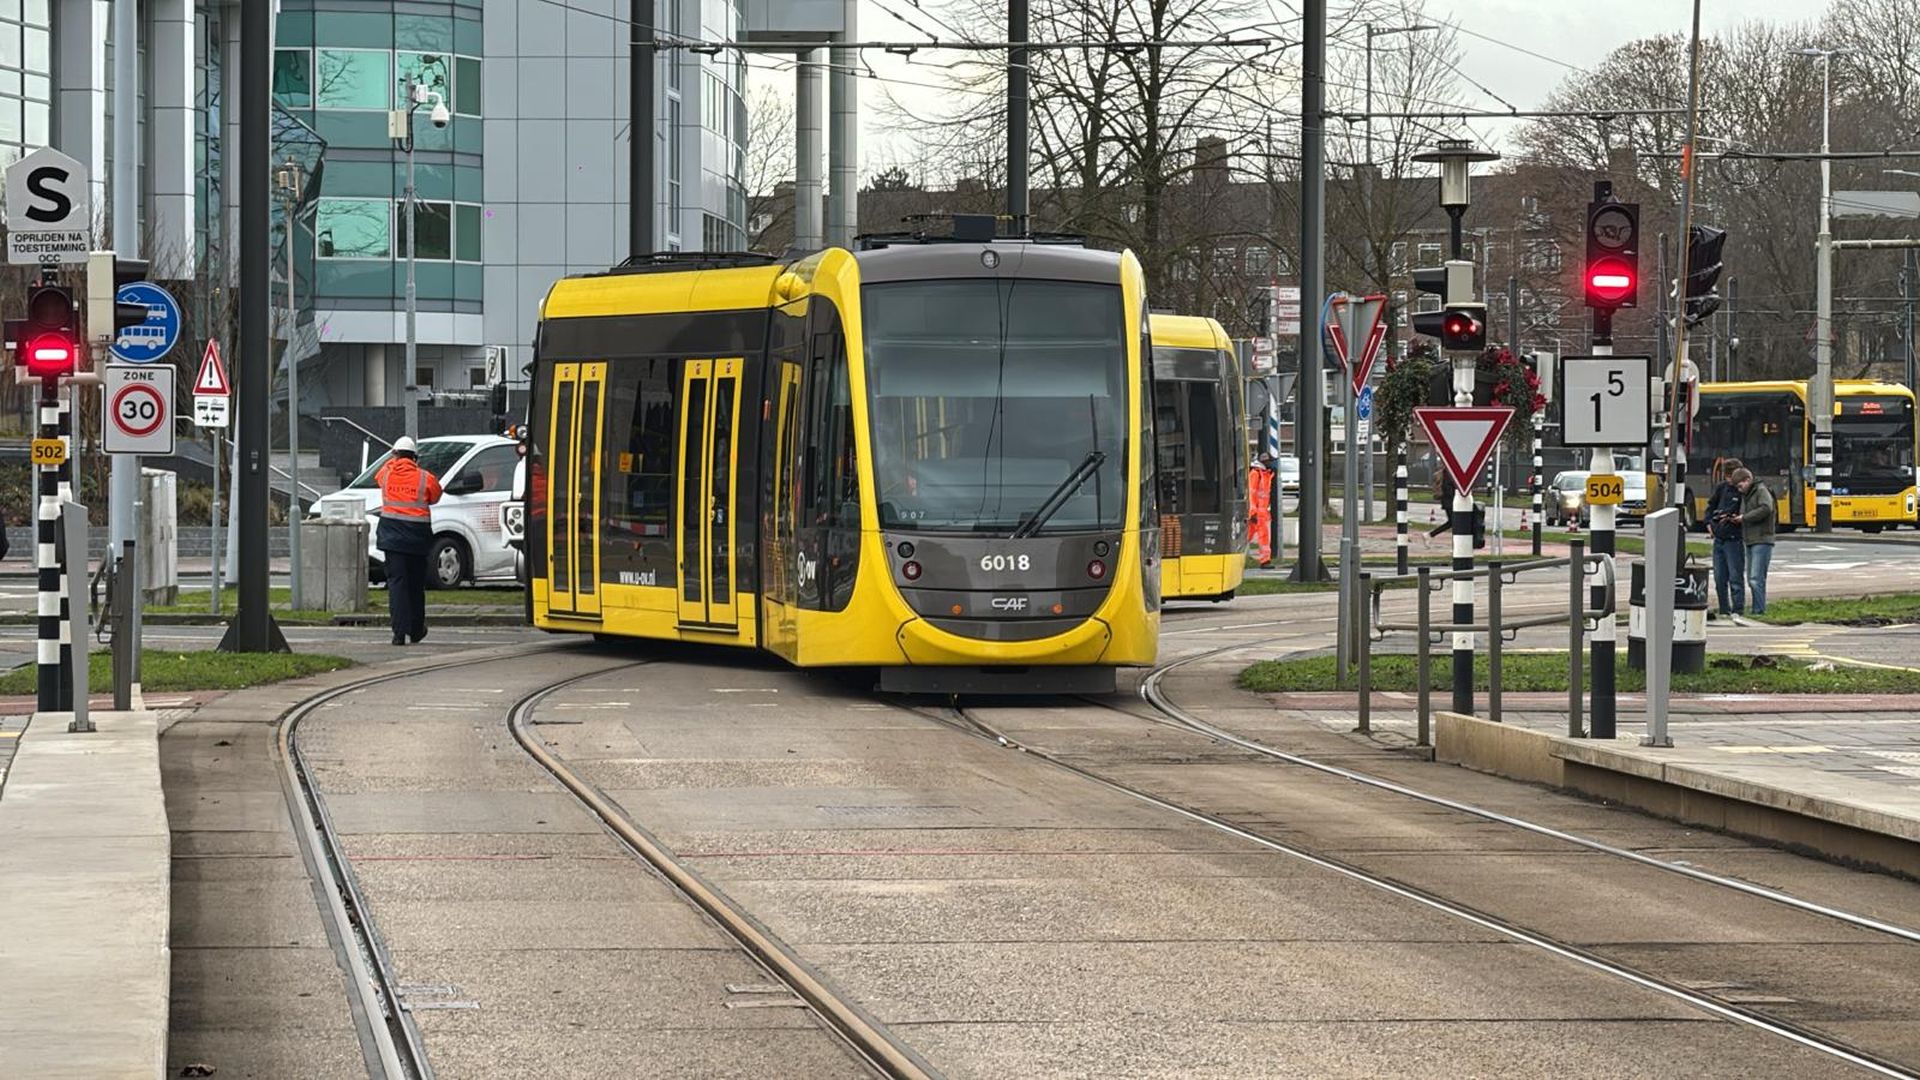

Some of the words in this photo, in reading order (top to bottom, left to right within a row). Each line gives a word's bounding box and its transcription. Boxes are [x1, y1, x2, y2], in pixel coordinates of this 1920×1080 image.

[25, 166, 71, 222] S
[15, 233, 65, 242] OPRIJDEN
[69, 233, 82, 241] NA
[13, 243, 86, 252] TOESTEMMING
[38, 254, 61, 262] OCC
[123, 371, 154, 381] ZONE
[1589, 392, 1602, 432] 1
[1607, 370, 1624, 397] 5
[122, 400, 155, 420] 30
[35, 446, 63, 459] 502
[1590, 483, 1621, 497] 504
[901, 511, 924, 519] 907
[980, 554, 1030, 571] 6018
[991, 597, 1028, 611] CAF
